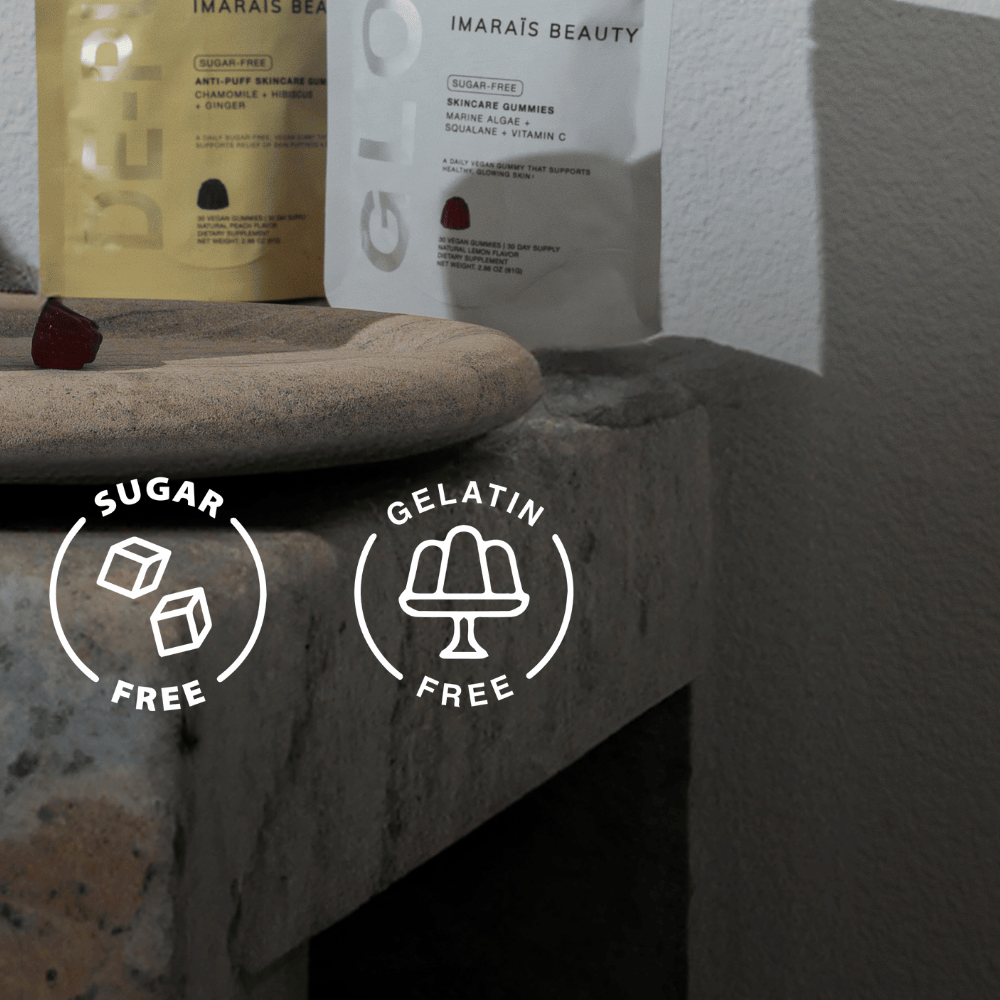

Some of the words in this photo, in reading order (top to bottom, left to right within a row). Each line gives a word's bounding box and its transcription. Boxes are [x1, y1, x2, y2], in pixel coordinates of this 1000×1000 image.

[451, 16, 538, 37] IMARAÏS
[550, 23, 639, 43] BEAUTY
[199, 59, 266, 67] SUGAR-FREE
[195, 77, 251, 85] ANTI-PUFF
[256, 77, 304, 85] SKINCARE
[452, 79, 516, 92] SUGAR-FREE
[195, 90, 258, 98] CHAMOMILE
[205, 101, 245, 110] GINGER
[447, 98, 498, 110] SKINCARE
[503, 103, 555, 114] GUMMIES
[446, 112, 483, 122] MARINE
[487, 116, 520, 126] ALGAE
[445, 124, 497, 135] SQUALANE
[512, 129, 554, 140] VITAMIN
[559, 133, 566, 141] C
[477, 169, 509, 178] GLOWING
[549, 167, 590, 175] SUPPORTS
